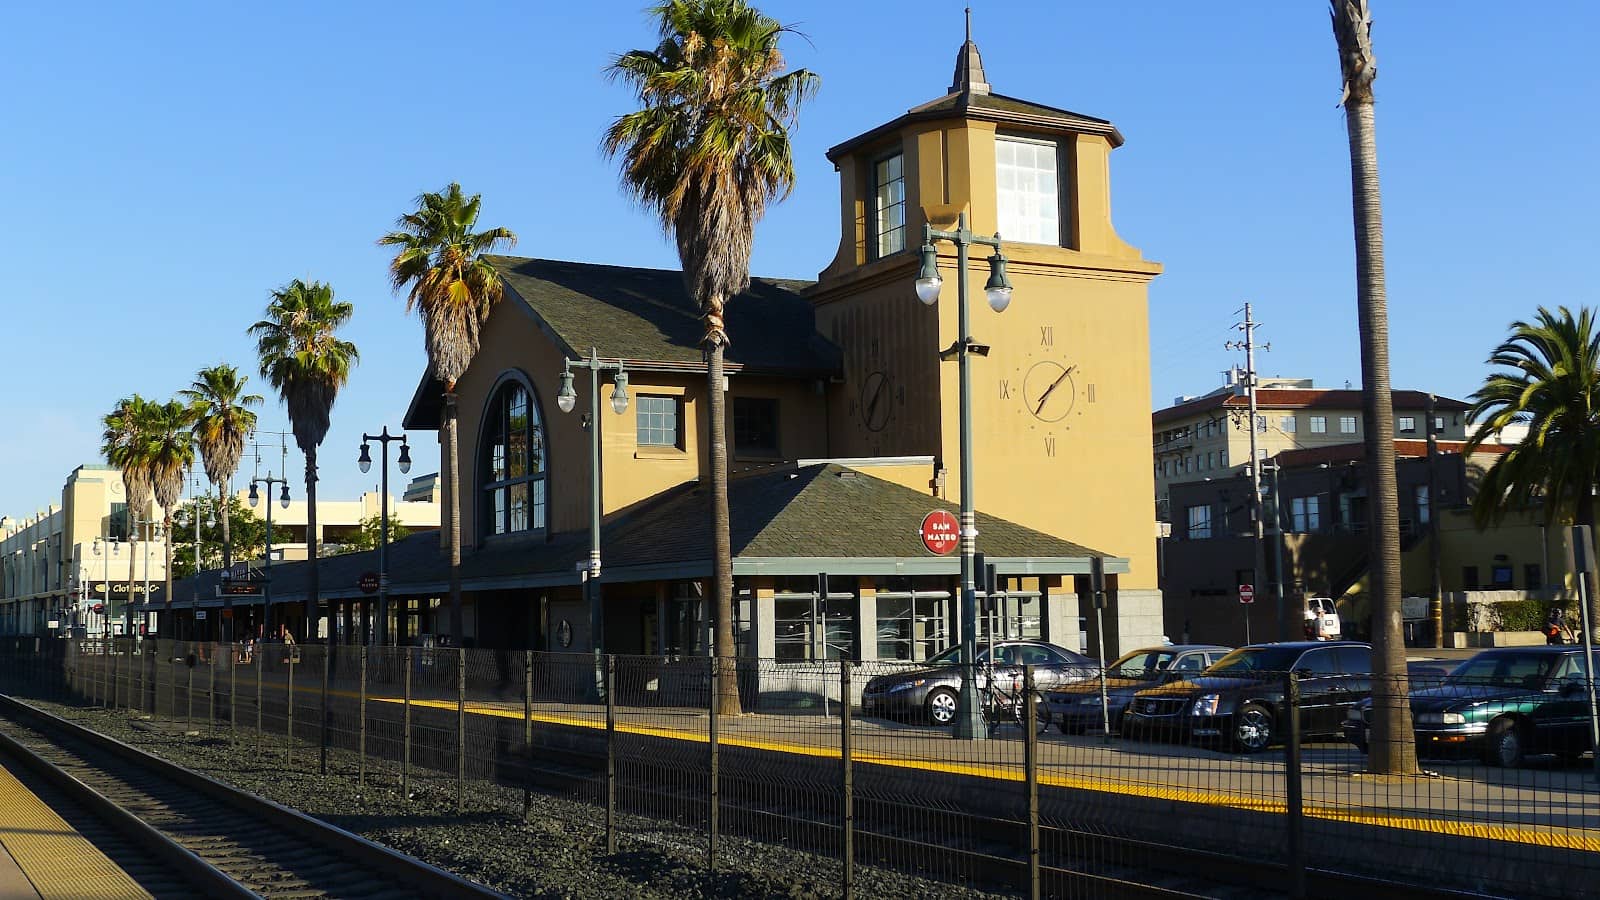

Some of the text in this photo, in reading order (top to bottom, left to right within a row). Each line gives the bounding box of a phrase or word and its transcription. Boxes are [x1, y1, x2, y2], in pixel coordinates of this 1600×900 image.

[1040, 326, 1053, 346] XII
[999, 379, 1010, 400] IX
[1087, 383, 1095, 403] III
[1044, 437, 1056, 457] VI
[932, 522, 950, 531] SAN
[927, 533, 957, 542] MATEO
[113, 584, 147, 594] Cloting
